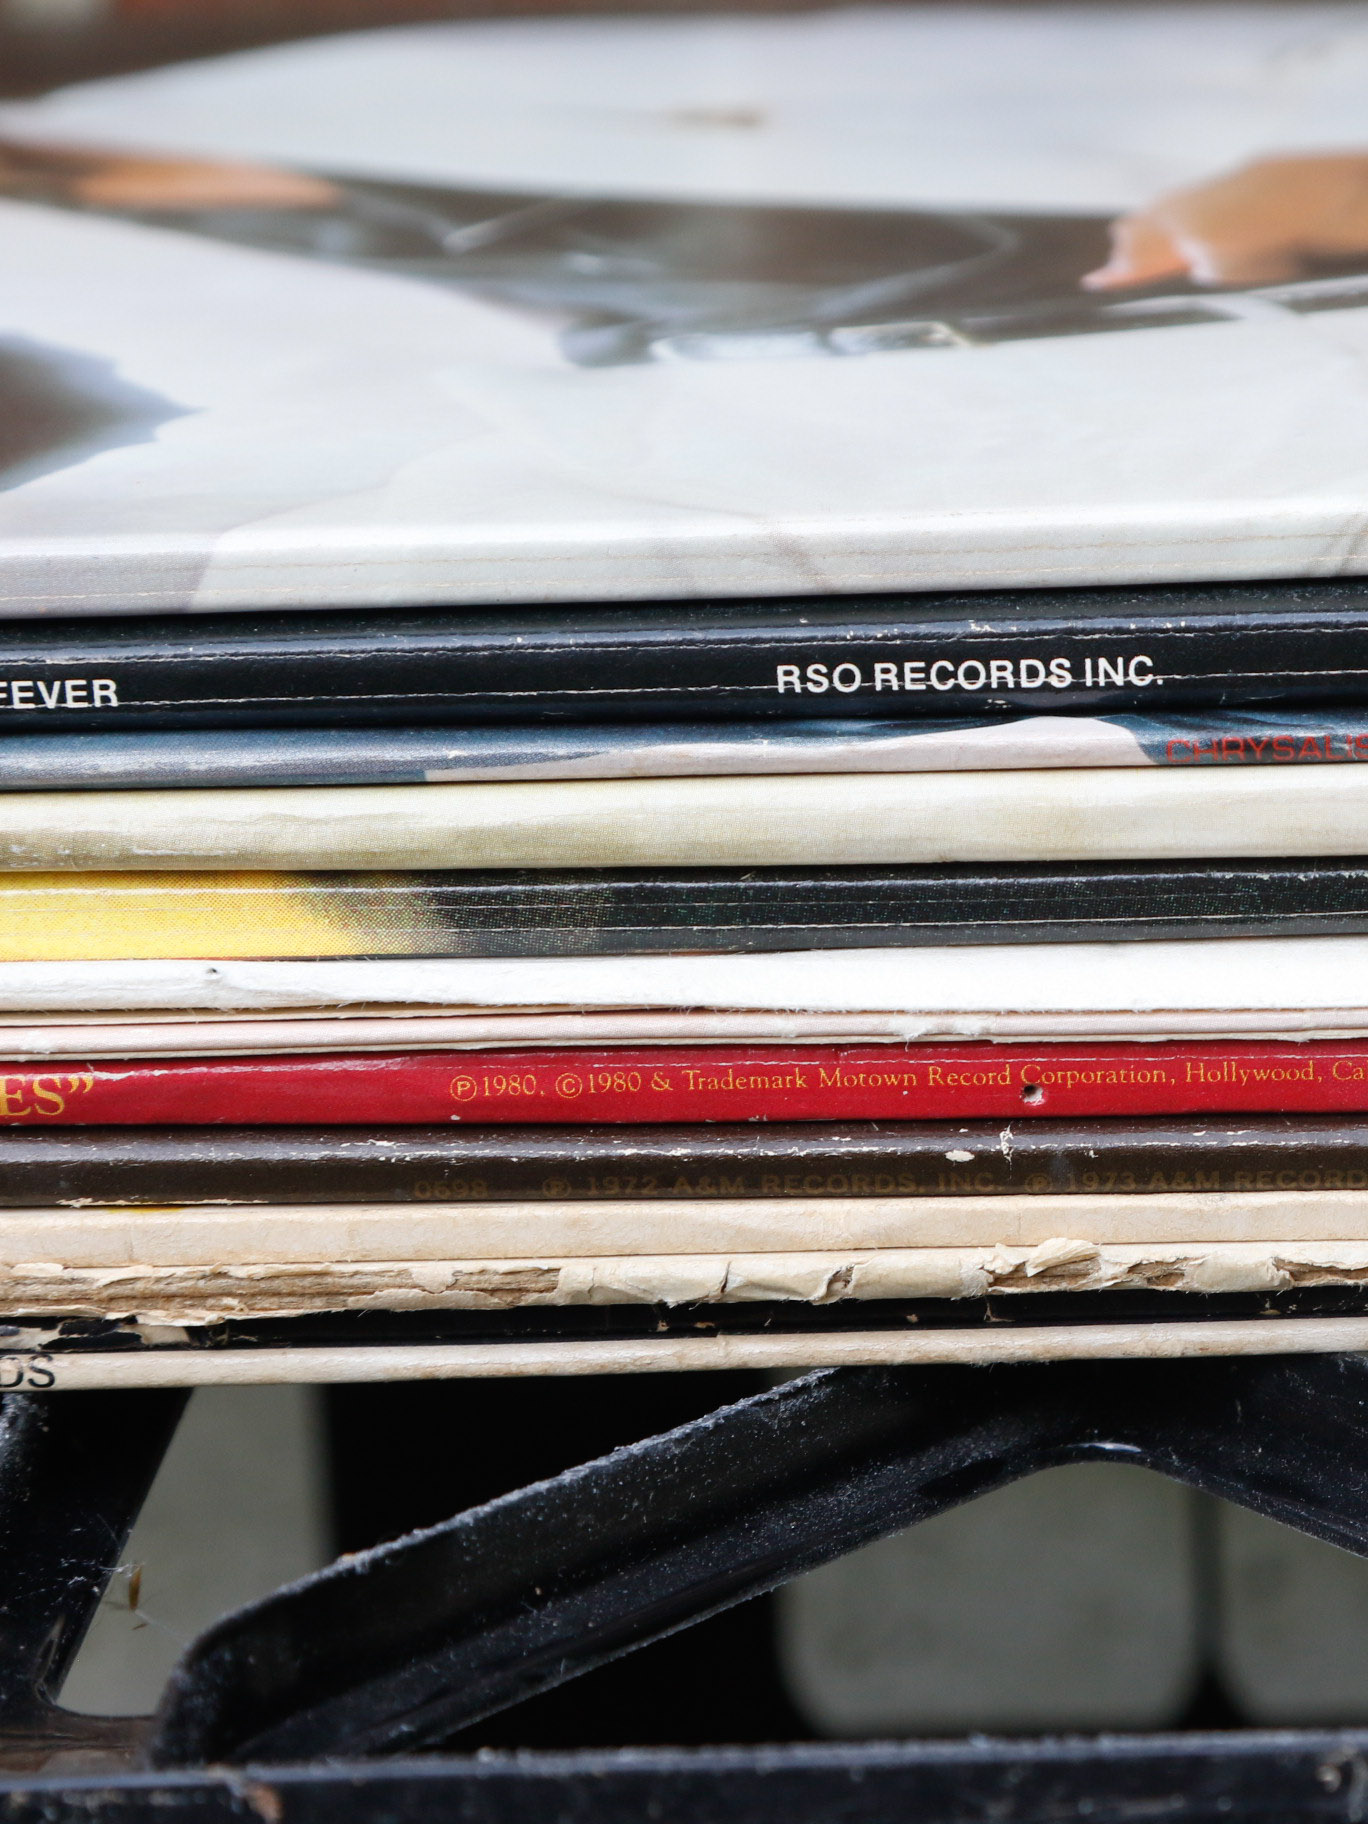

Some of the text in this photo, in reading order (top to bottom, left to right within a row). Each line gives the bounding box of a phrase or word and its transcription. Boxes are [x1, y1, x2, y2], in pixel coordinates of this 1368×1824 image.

[775, 655, 1164, 694] RSO RECORDS INC.
[651, 1072, 674, 1091] &
[681, 1067, 807, 1092] Trademark
[819, 1066, 917, 1089] Motown
[927, 1064, 1012, 1087] Record
[1020, 1062, 1176, 1090] Corporation,
[1185, 1059, 1323, 1087] Hollywood,
[671, 1175, 746, 1195] A&M
[1149, 1170, 1220, 1191] A&M
